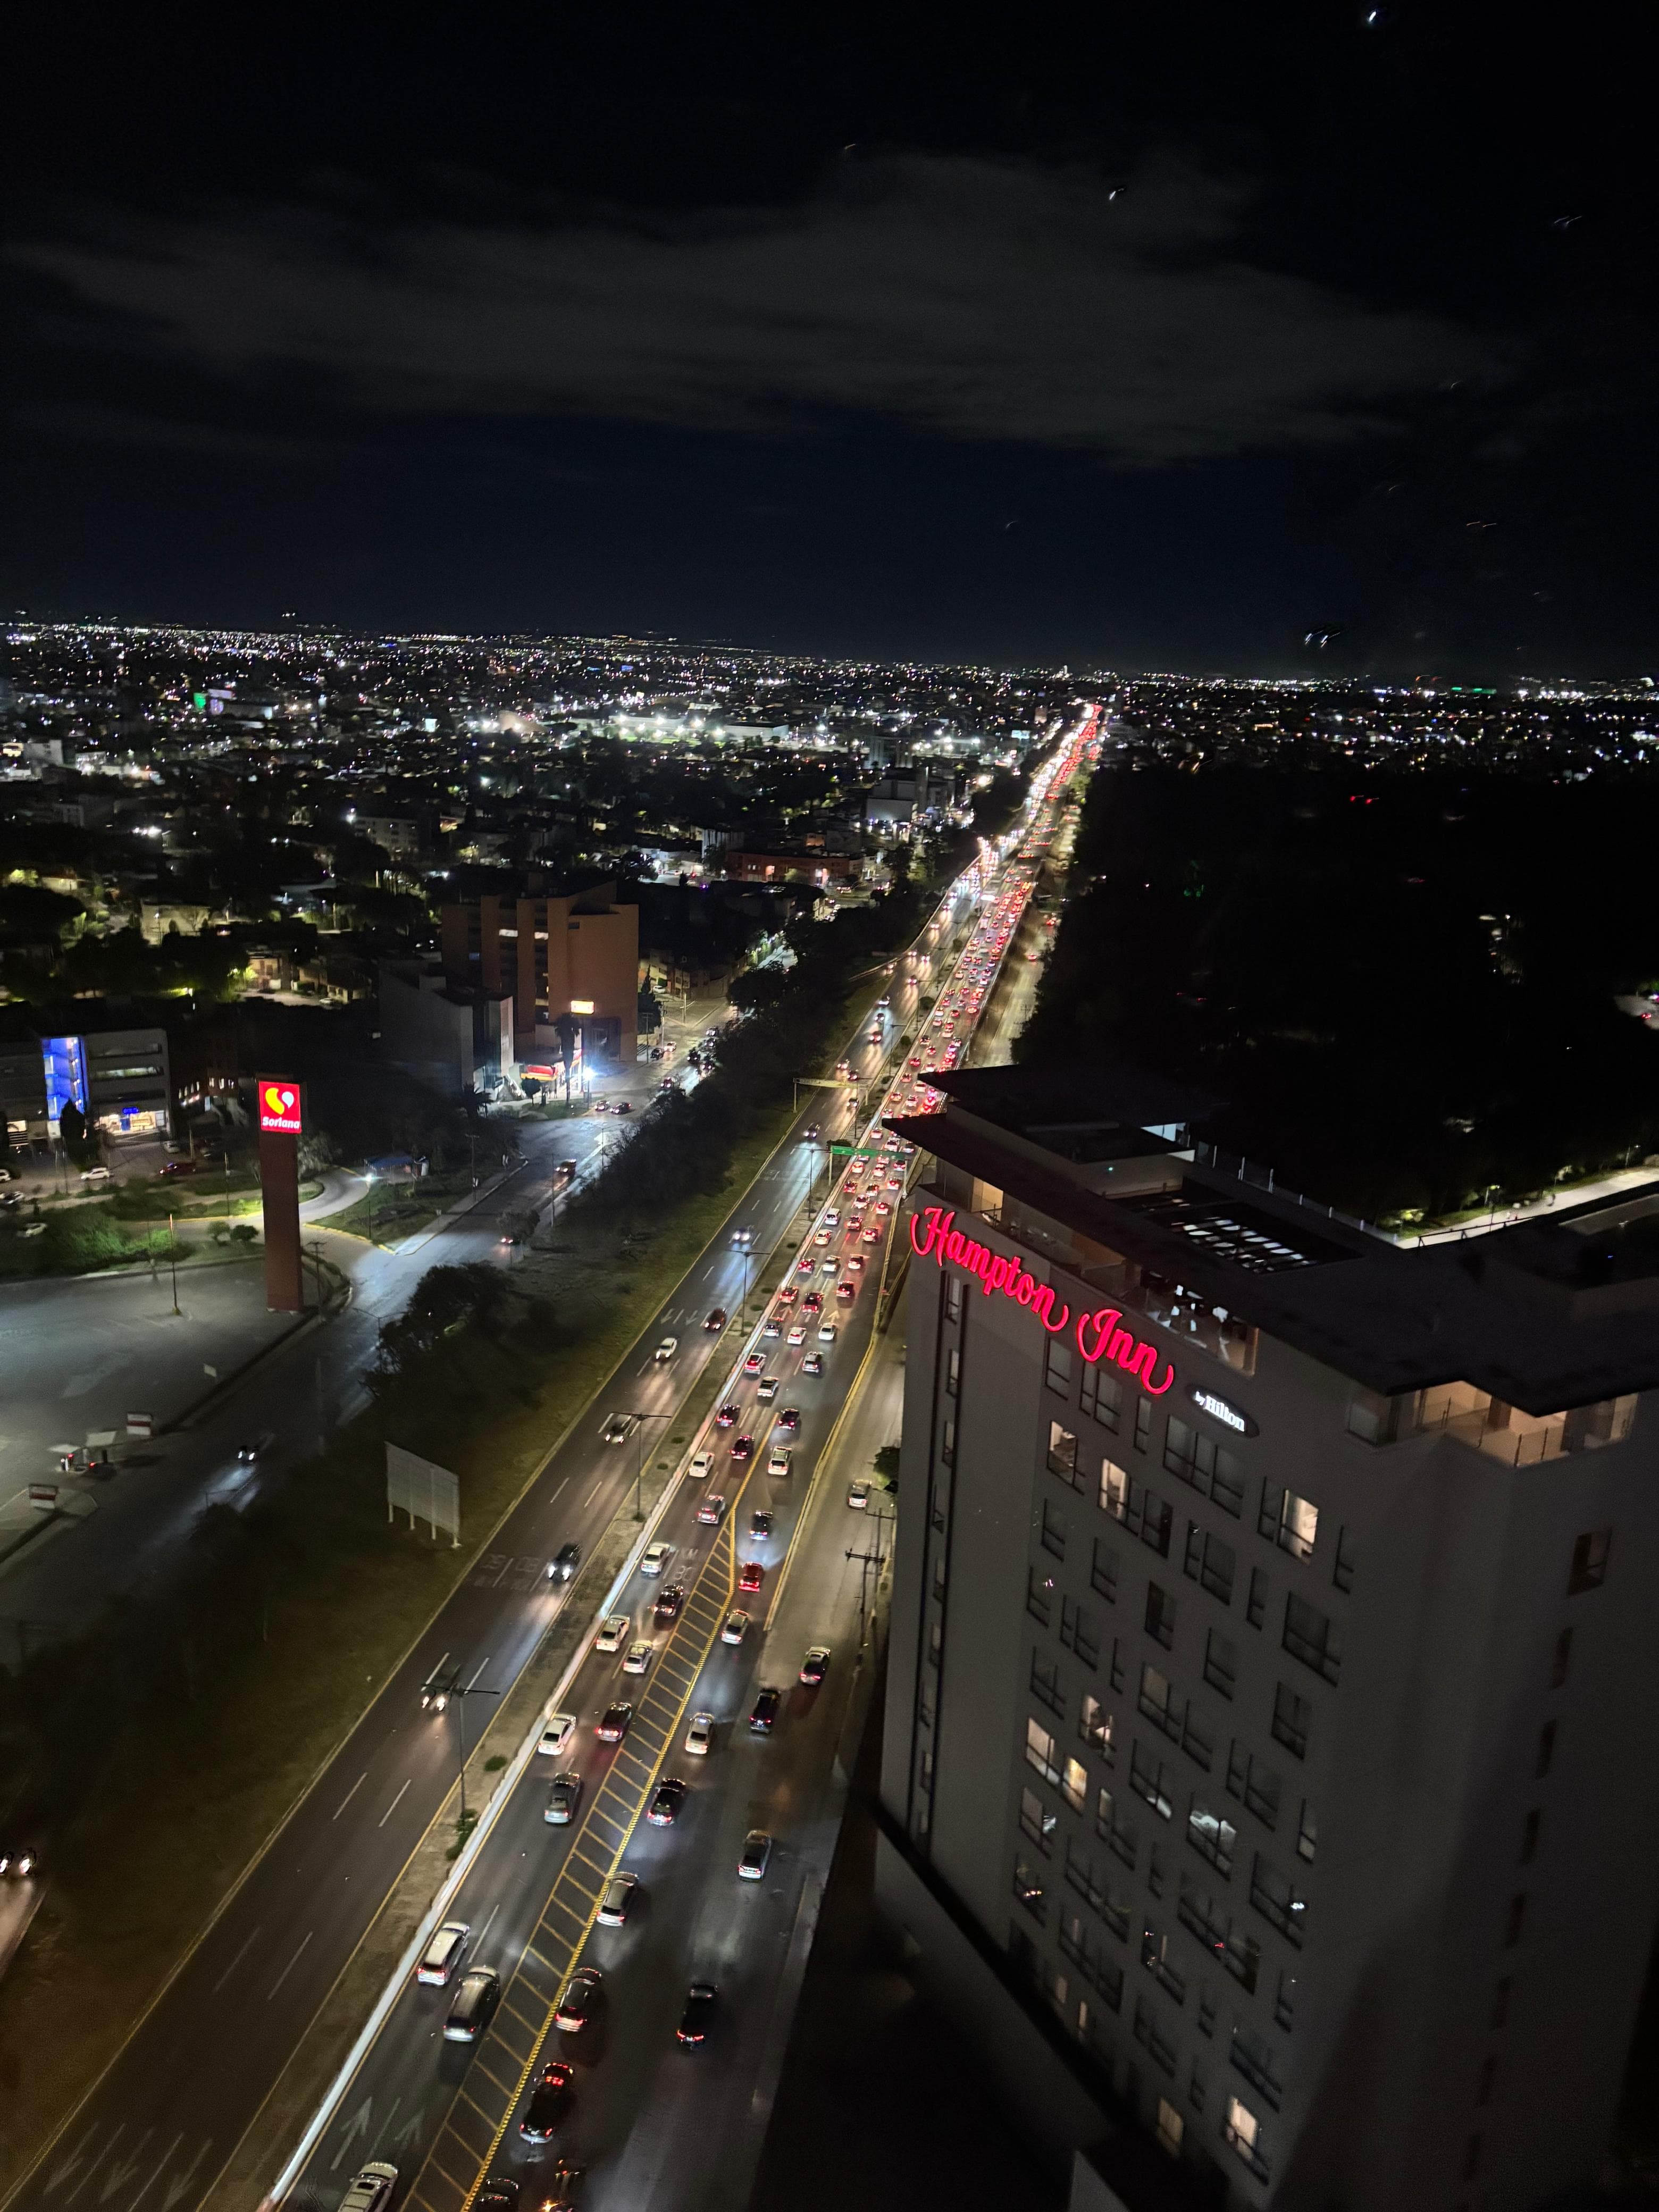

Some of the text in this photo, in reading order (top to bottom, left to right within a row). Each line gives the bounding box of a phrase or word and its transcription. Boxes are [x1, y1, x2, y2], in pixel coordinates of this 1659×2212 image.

[262, 1116, 300, 1129] Soriana
[910, 1207, 1174, 1395] Hampton Inn
[1194, 1391, 1245, 1432] by Hilton
